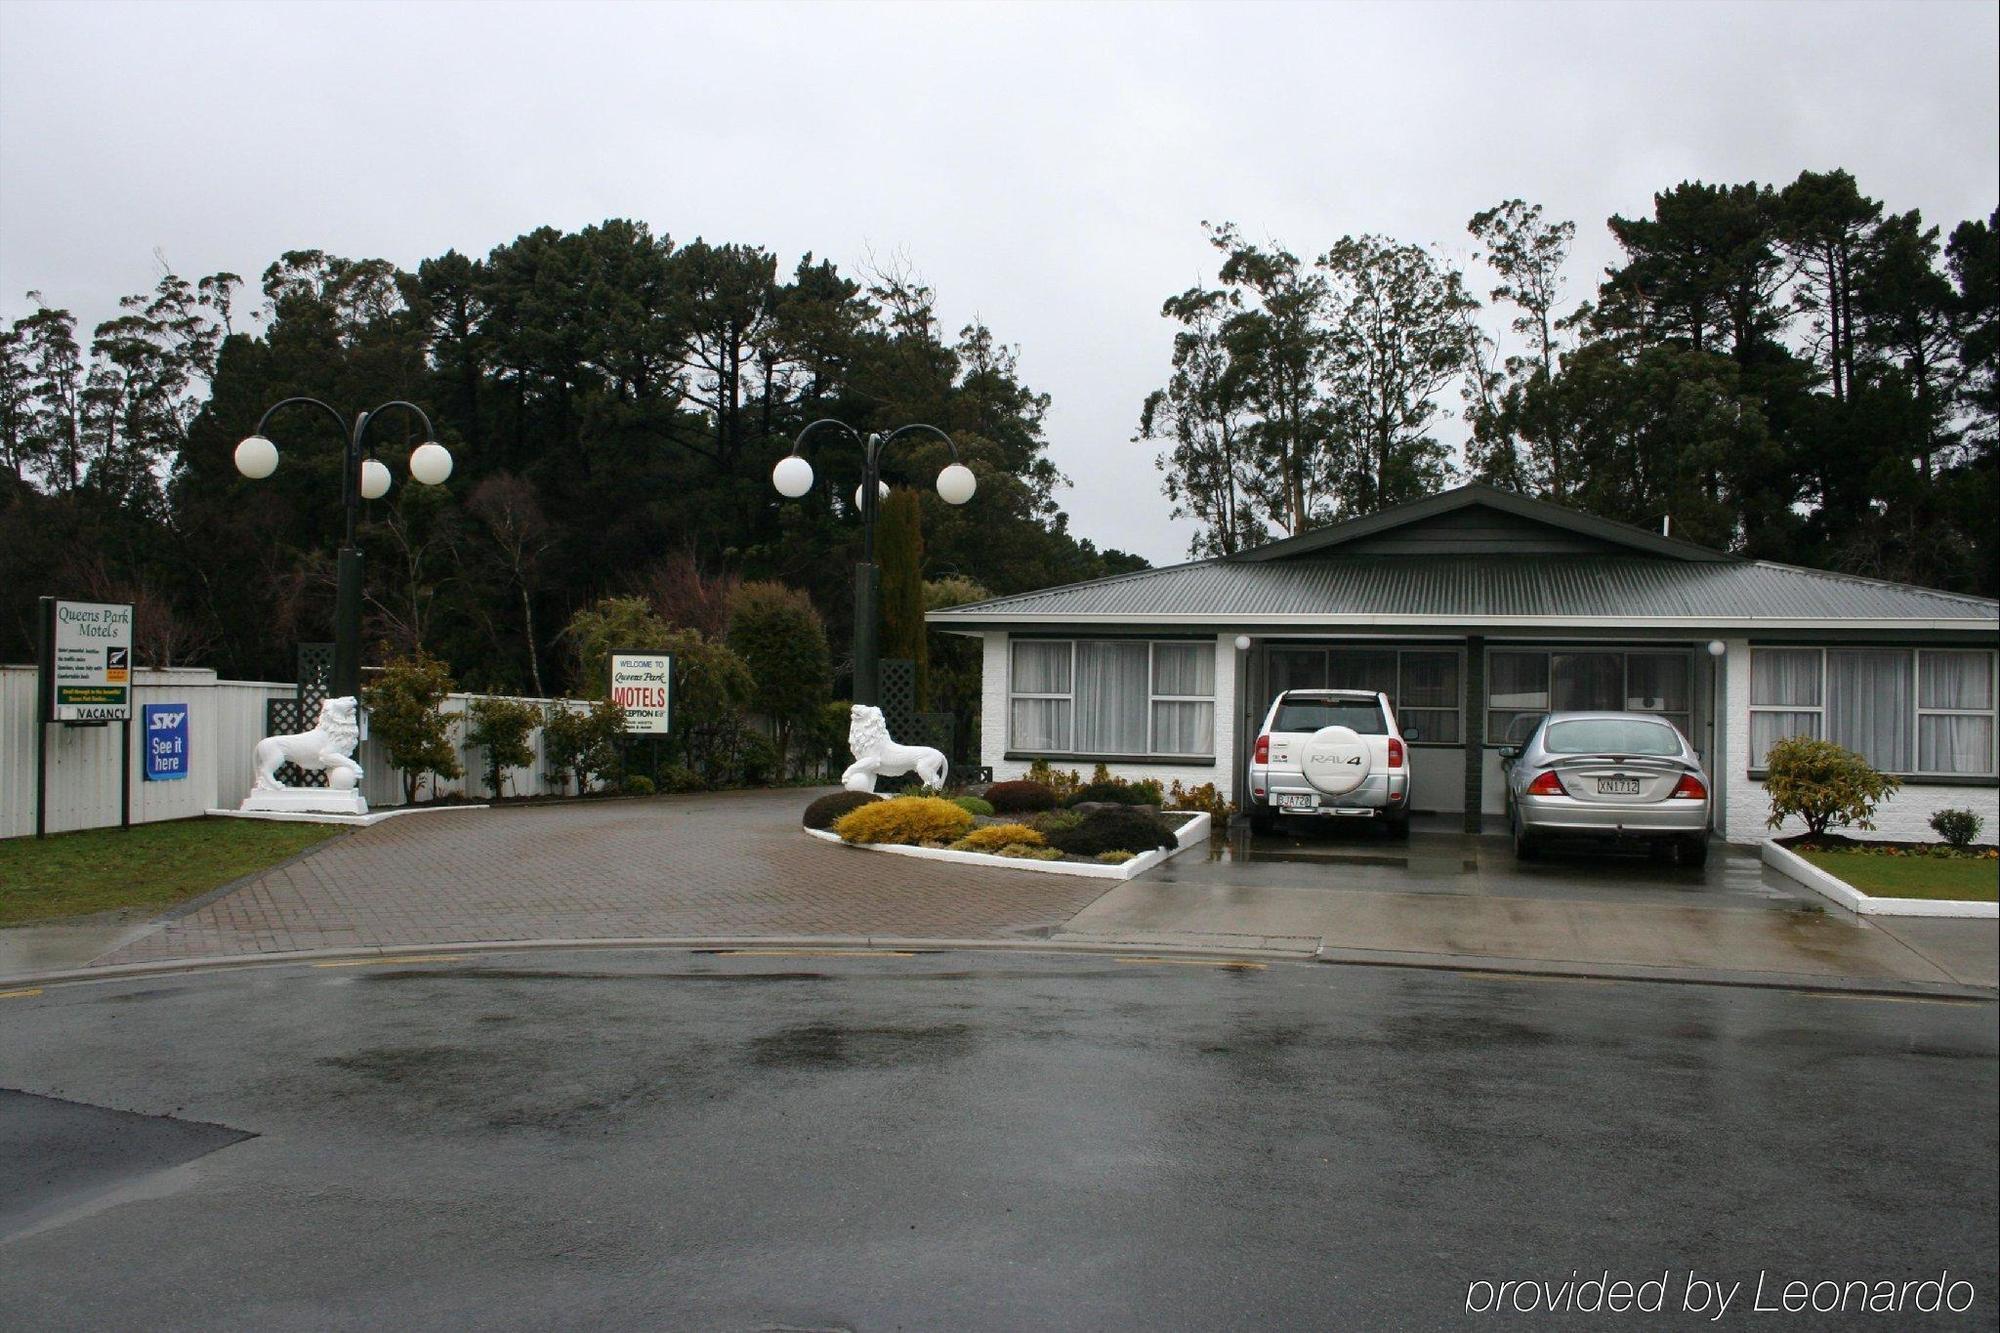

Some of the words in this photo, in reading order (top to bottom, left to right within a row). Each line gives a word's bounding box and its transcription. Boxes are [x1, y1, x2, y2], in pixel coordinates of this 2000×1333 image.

[58, 606, 100, 624] Queens
[104, 609, 129, 625] Park
[79, 623, 119, 638] Motels
[620, 660, 652, 668] WELCOME
[655, 660, 664, 668] TO
[643, 672, 667, 684] Park
[614, 687, 665, 707] MOTELS
[80, 708, 126, 719] VACANCY
[149, 712, 185, 730] SKY
[152, 737, 172, 754] See
[174, 736, 183, 753] it
[155, 755, 179, 771] here
[1311, 754, 1362, 766] RAV4
[1600, 781, 1638, 792] XN1712
